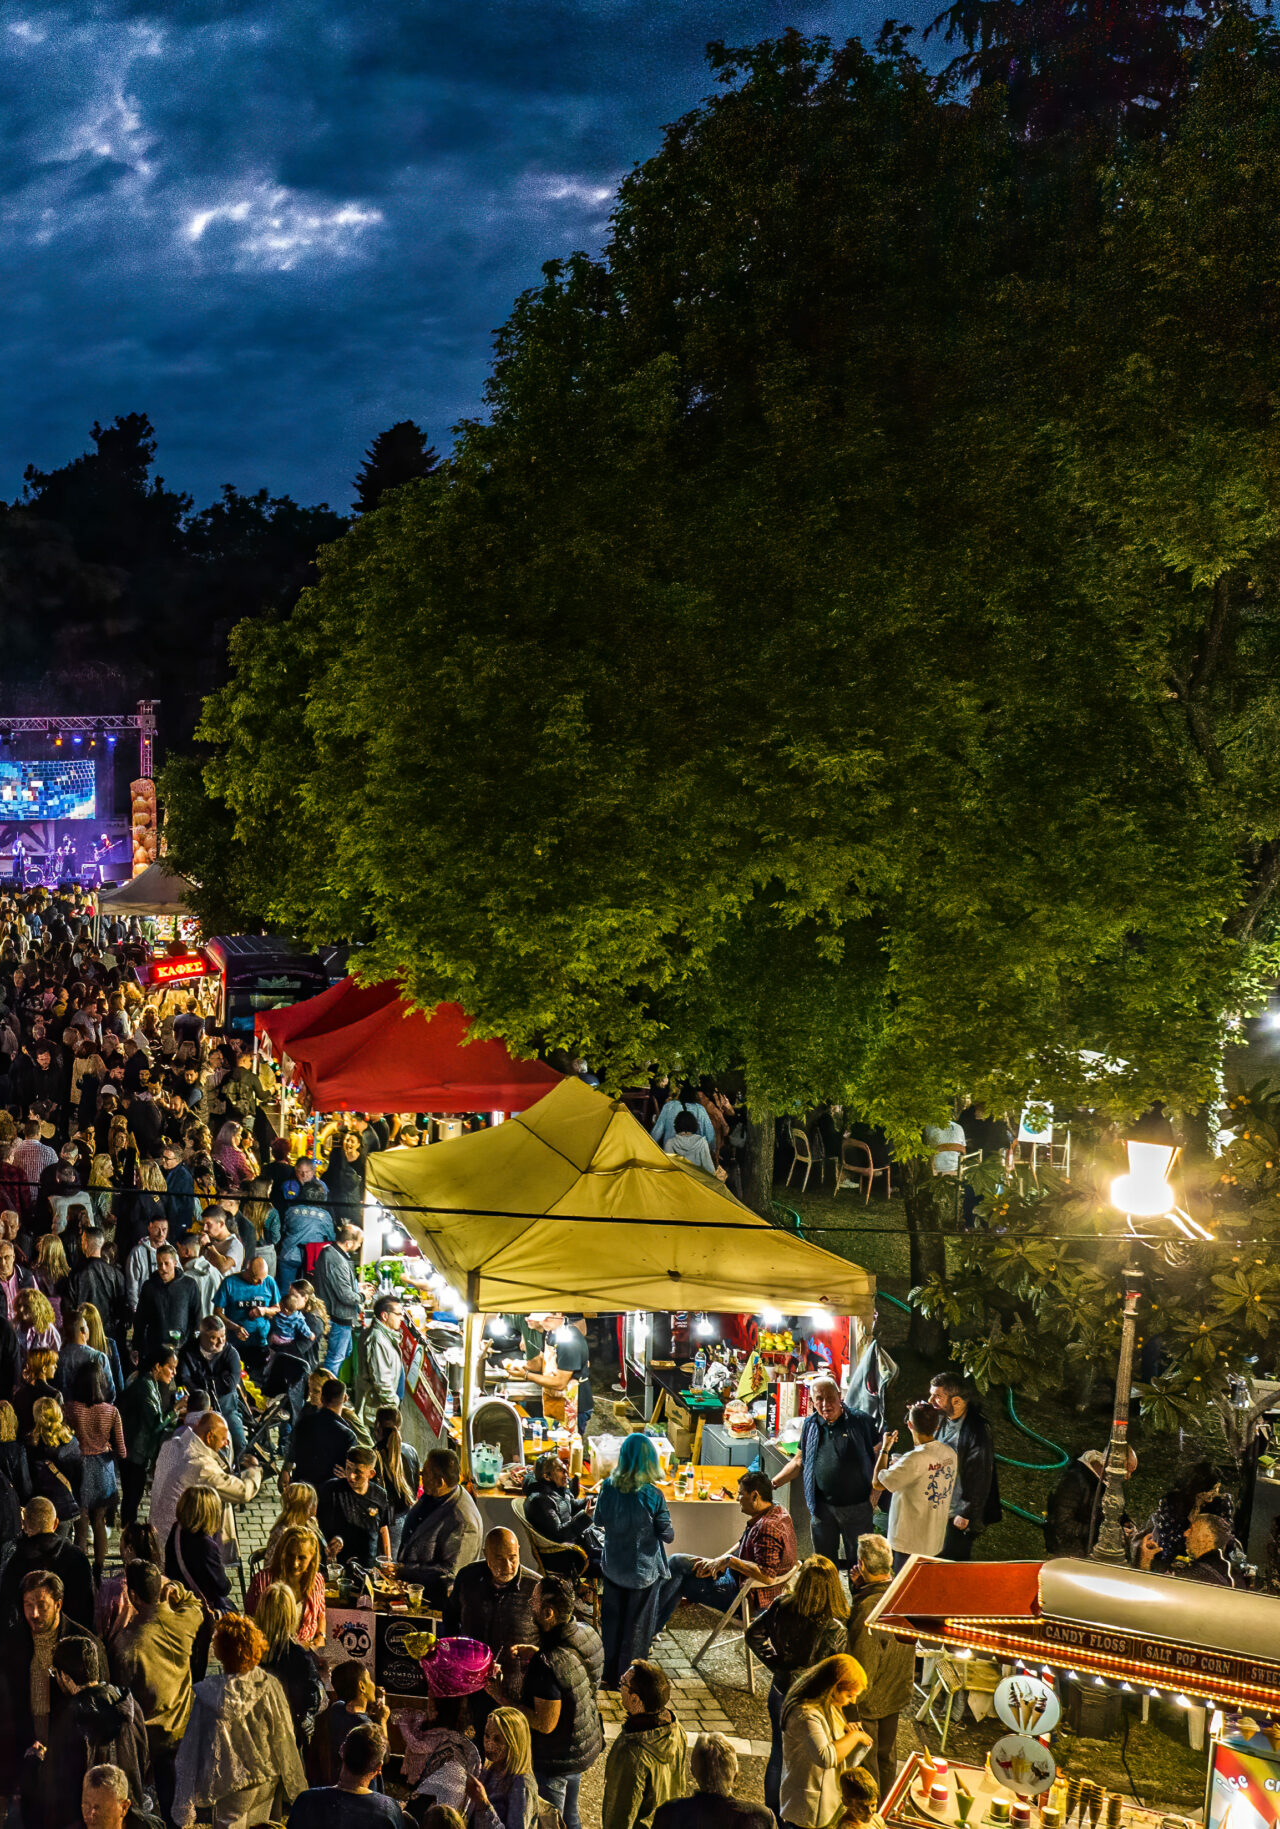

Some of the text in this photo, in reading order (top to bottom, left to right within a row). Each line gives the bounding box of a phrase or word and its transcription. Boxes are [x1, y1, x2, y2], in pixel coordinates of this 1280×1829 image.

[1045, 1625, 1127, 1653] CANDY FLOSS
[1145, 1645, 1232, 1675] SALT POP CORN
[1250, 1666, 1280, 1686] SWEE
